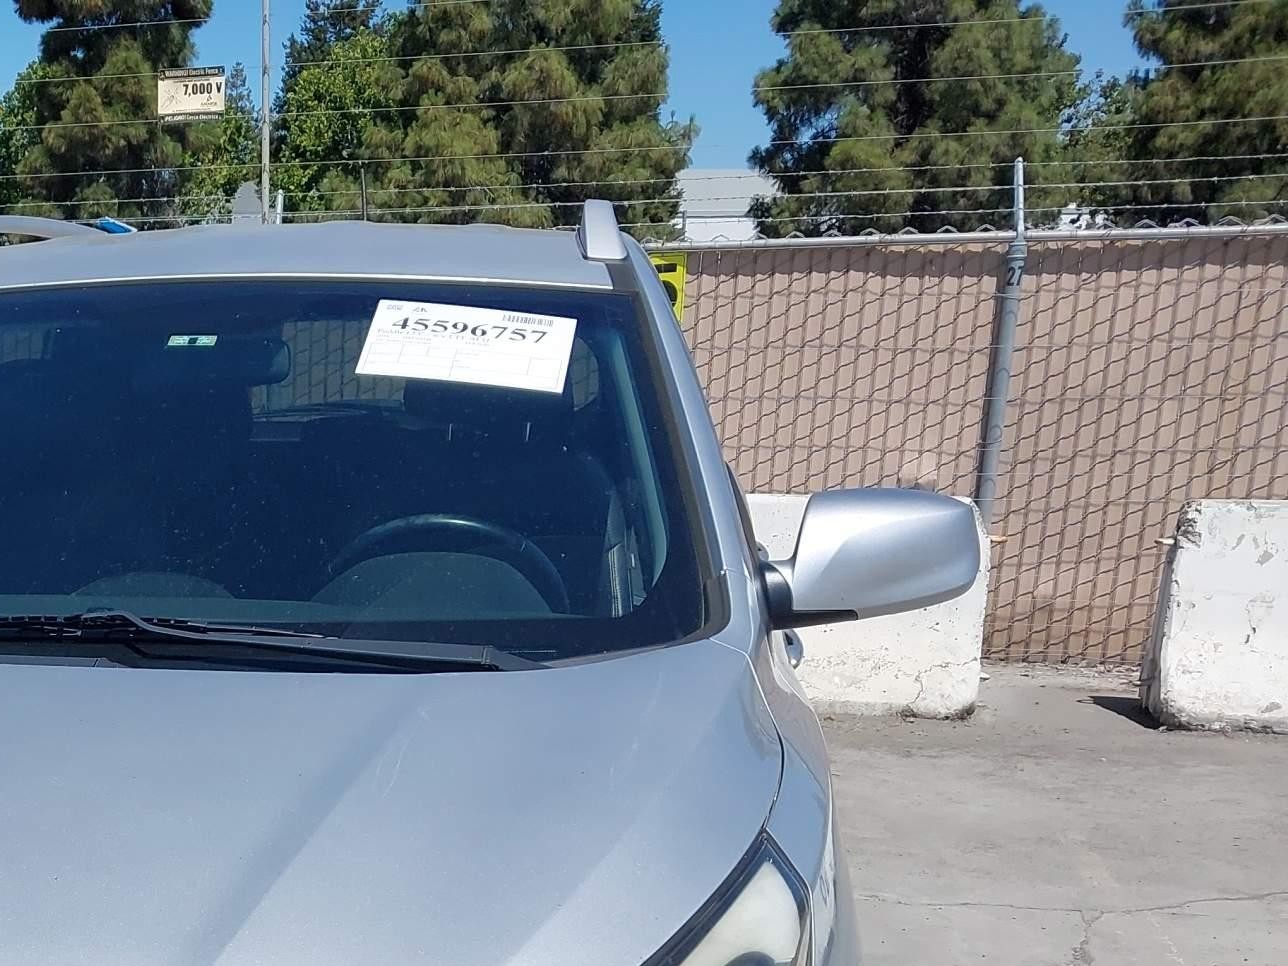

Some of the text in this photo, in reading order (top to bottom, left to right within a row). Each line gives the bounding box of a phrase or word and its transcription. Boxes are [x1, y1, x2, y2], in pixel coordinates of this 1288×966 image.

[183, 81, 223, 97] 7,000 V
[391, 316, 548, 344] 45596757
